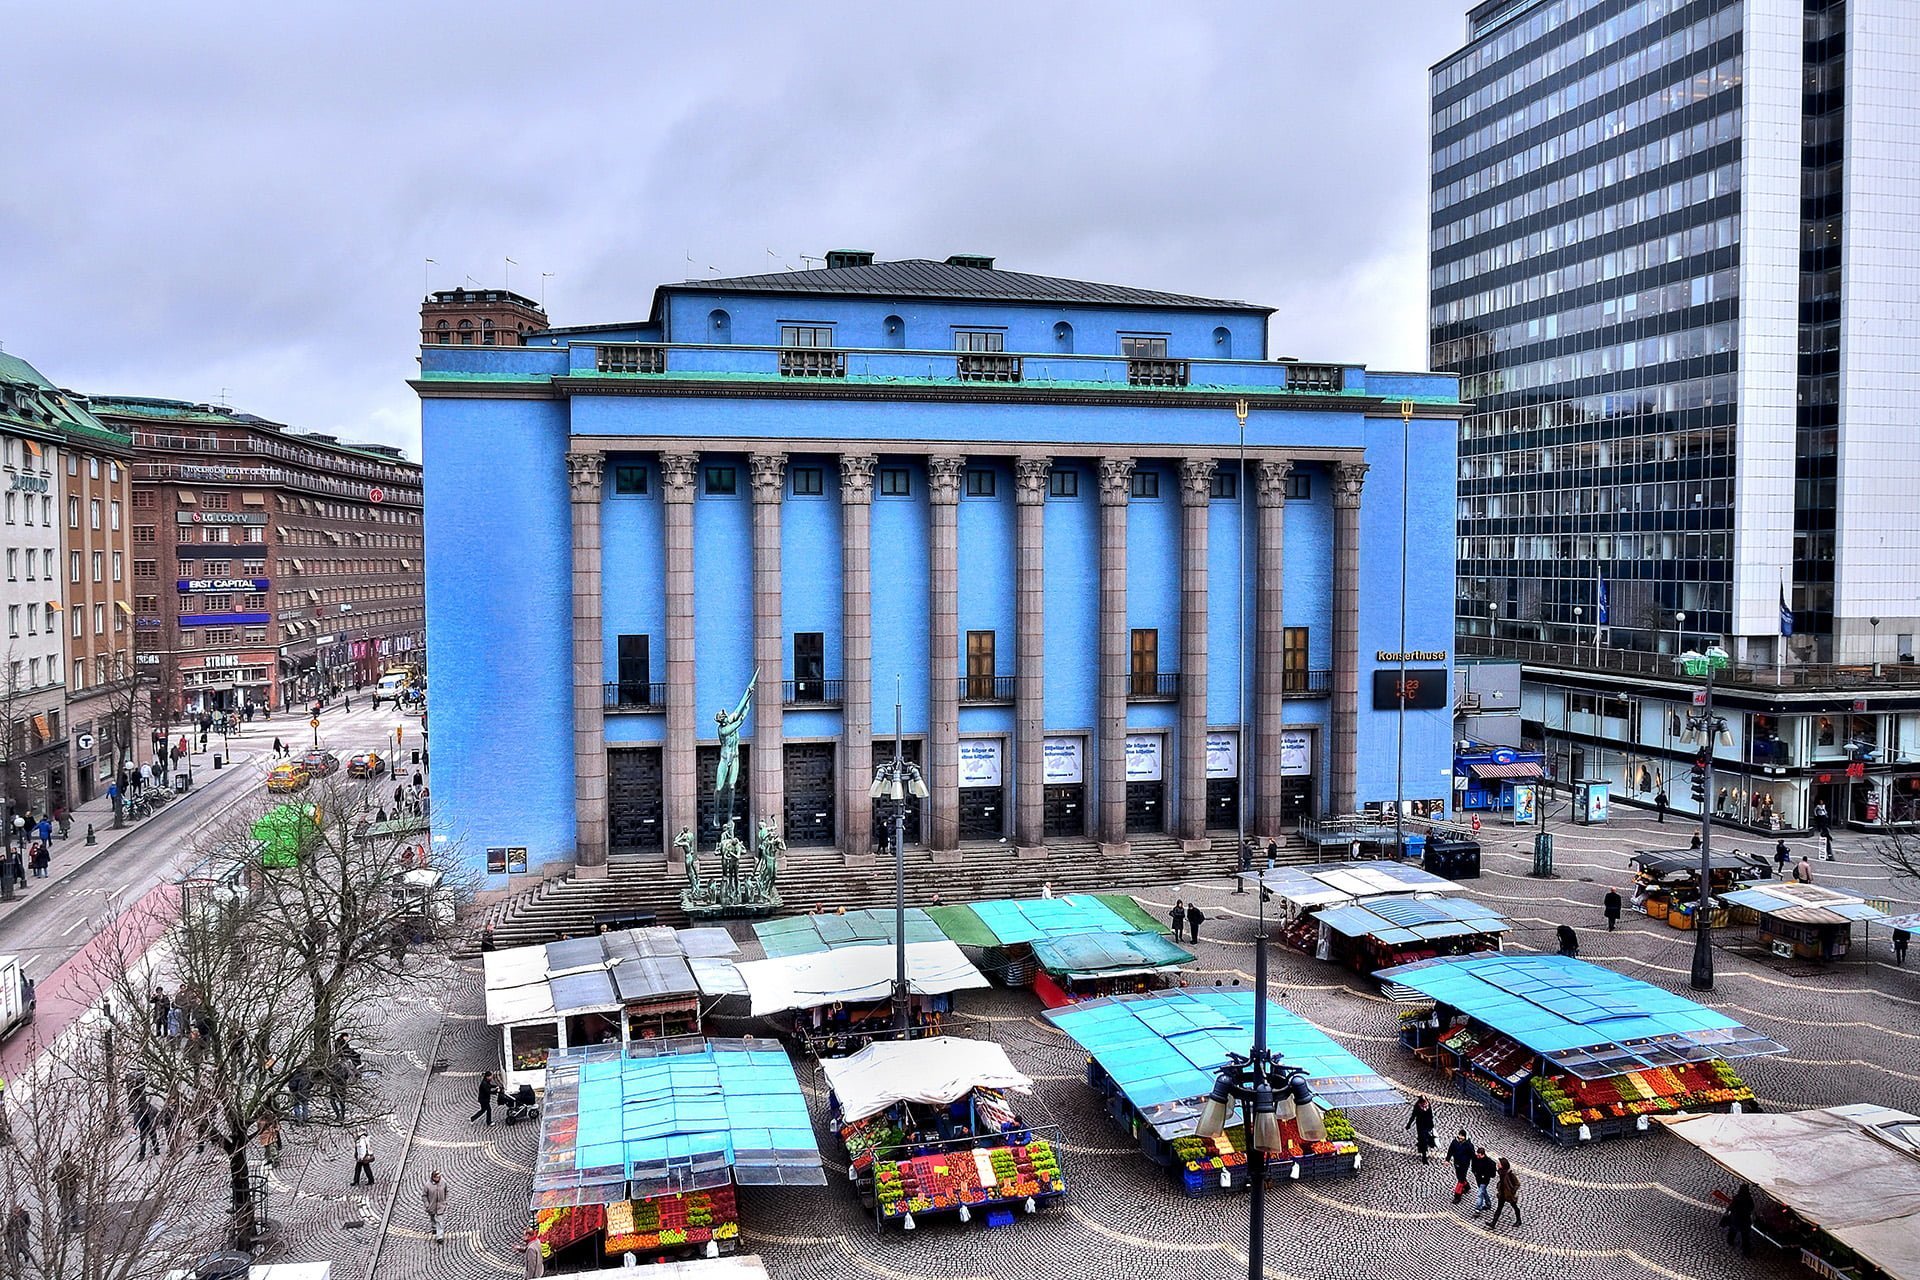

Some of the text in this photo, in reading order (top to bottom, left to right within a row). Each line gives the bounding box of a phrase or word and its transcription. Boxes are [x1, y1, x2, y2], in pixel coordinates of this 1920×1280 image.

[202, 513, 248, 523] LG LCD TV
[189, 579, 256, 589] EAST CAPITAL
[205, 653, 239, 668] STRÖMS
